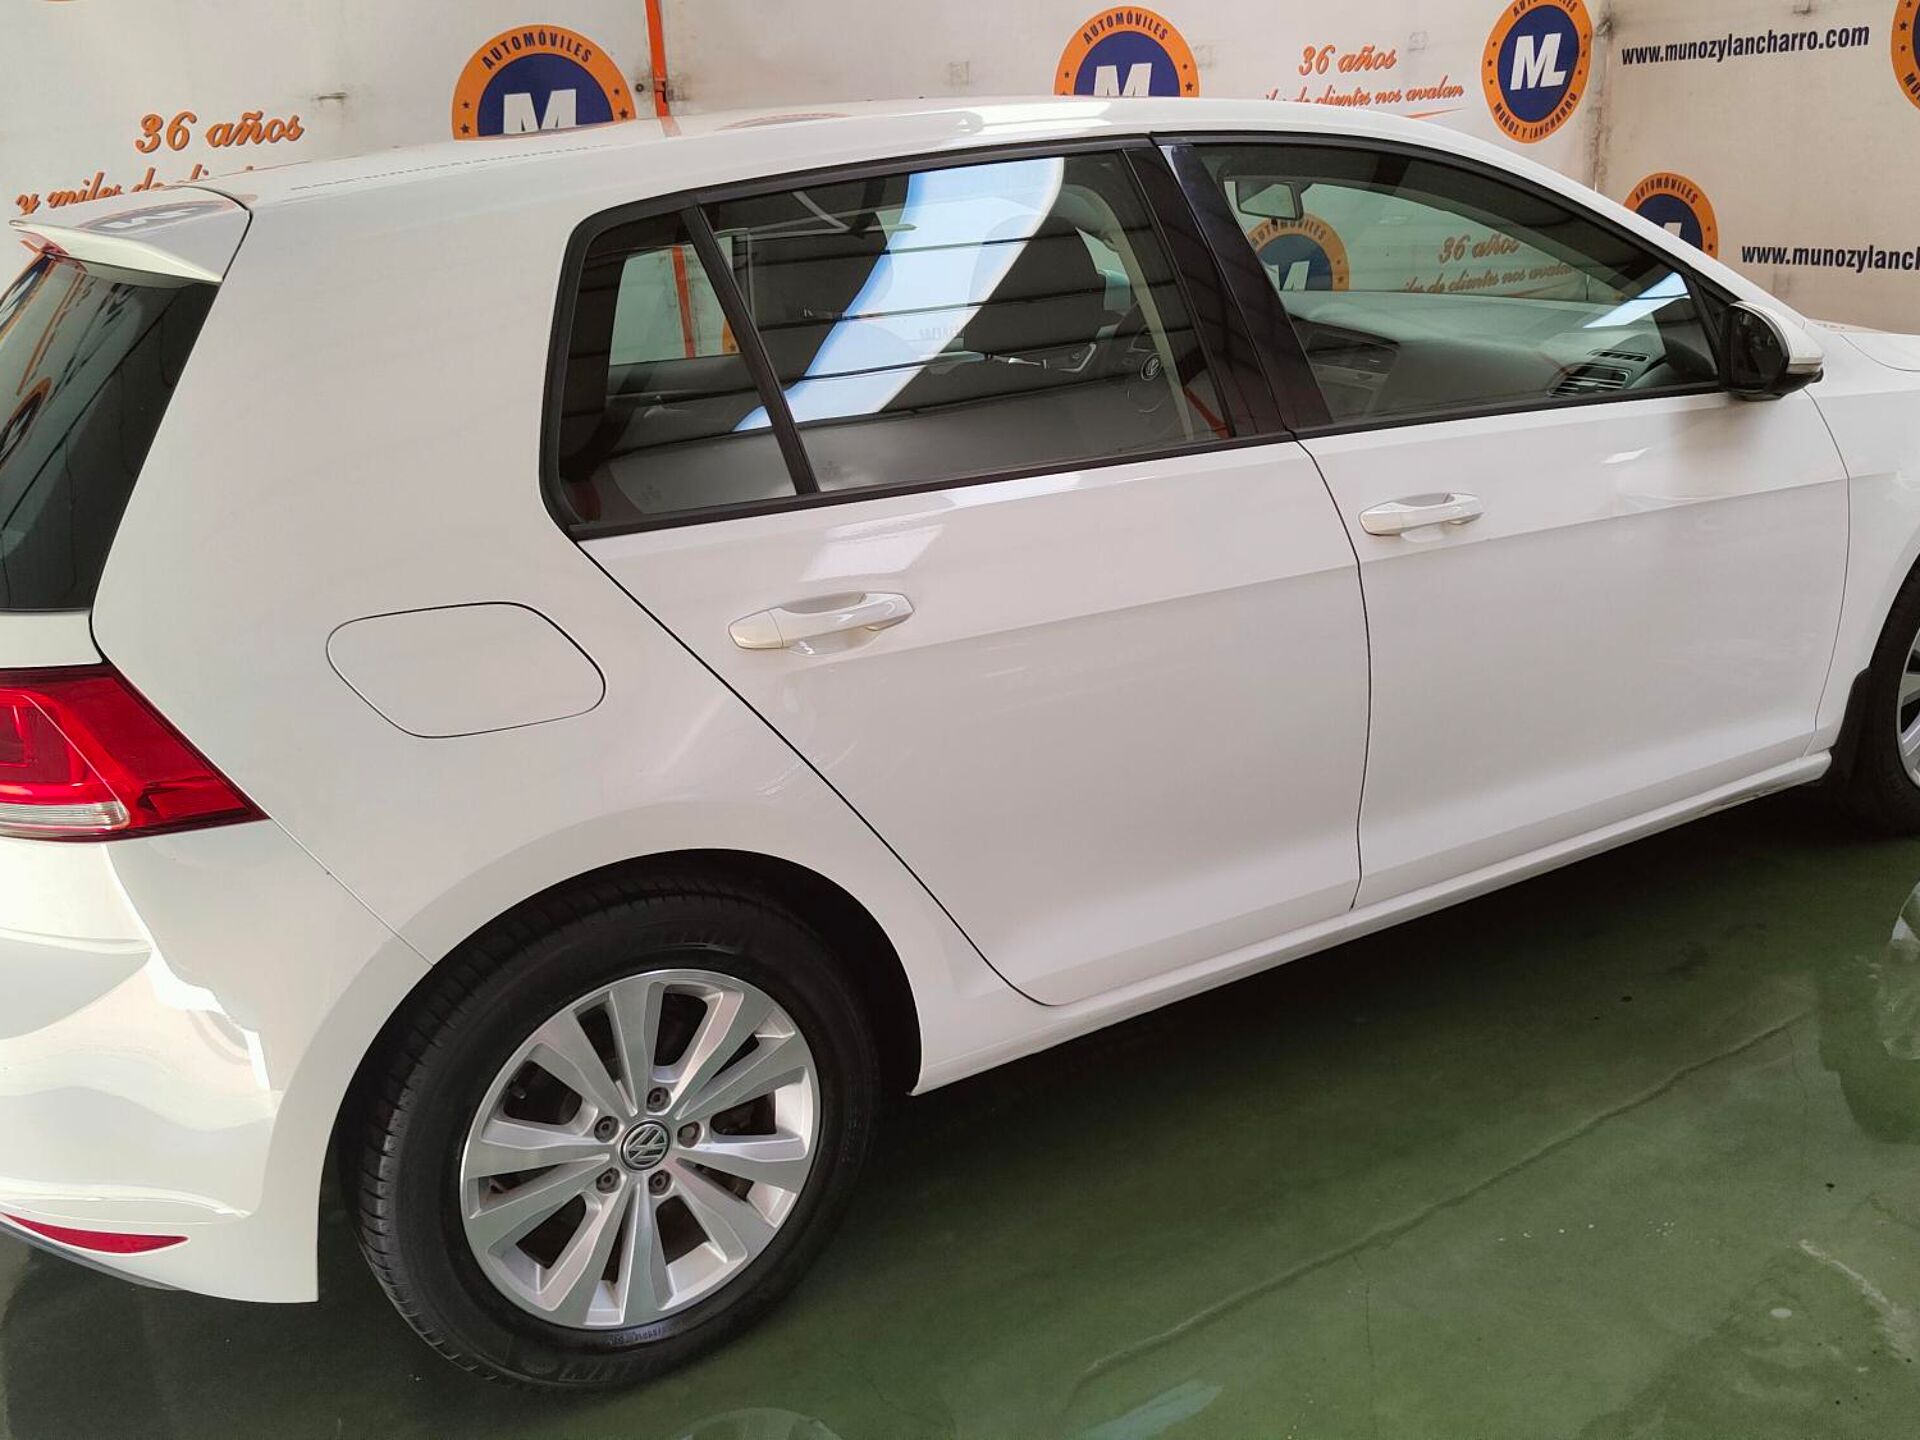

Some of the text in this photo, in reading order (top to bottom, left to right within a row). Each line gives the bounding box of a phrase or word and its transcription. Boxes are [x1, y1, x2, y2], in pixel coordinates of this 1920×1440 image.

[1083, 10, 1168, 44] AUTOMÓVILES
[481, 29, 592, 70] AUTOMÓVILES
[1298, 44, 1398, 76] 36 años
[1510, 32, 1567, 91] ML
[1622, 26, 1870, 66] www.munozylancharro.com
[1093, 62, 1152, 97] M
[1374, 88, 1403, 105] nos
[1406, 75, 1465, 101] avalan
[503, 88, 577, 135] M
[135, 110, 305, 154] 36 años
[1439, 234, 1471, 265] 36
